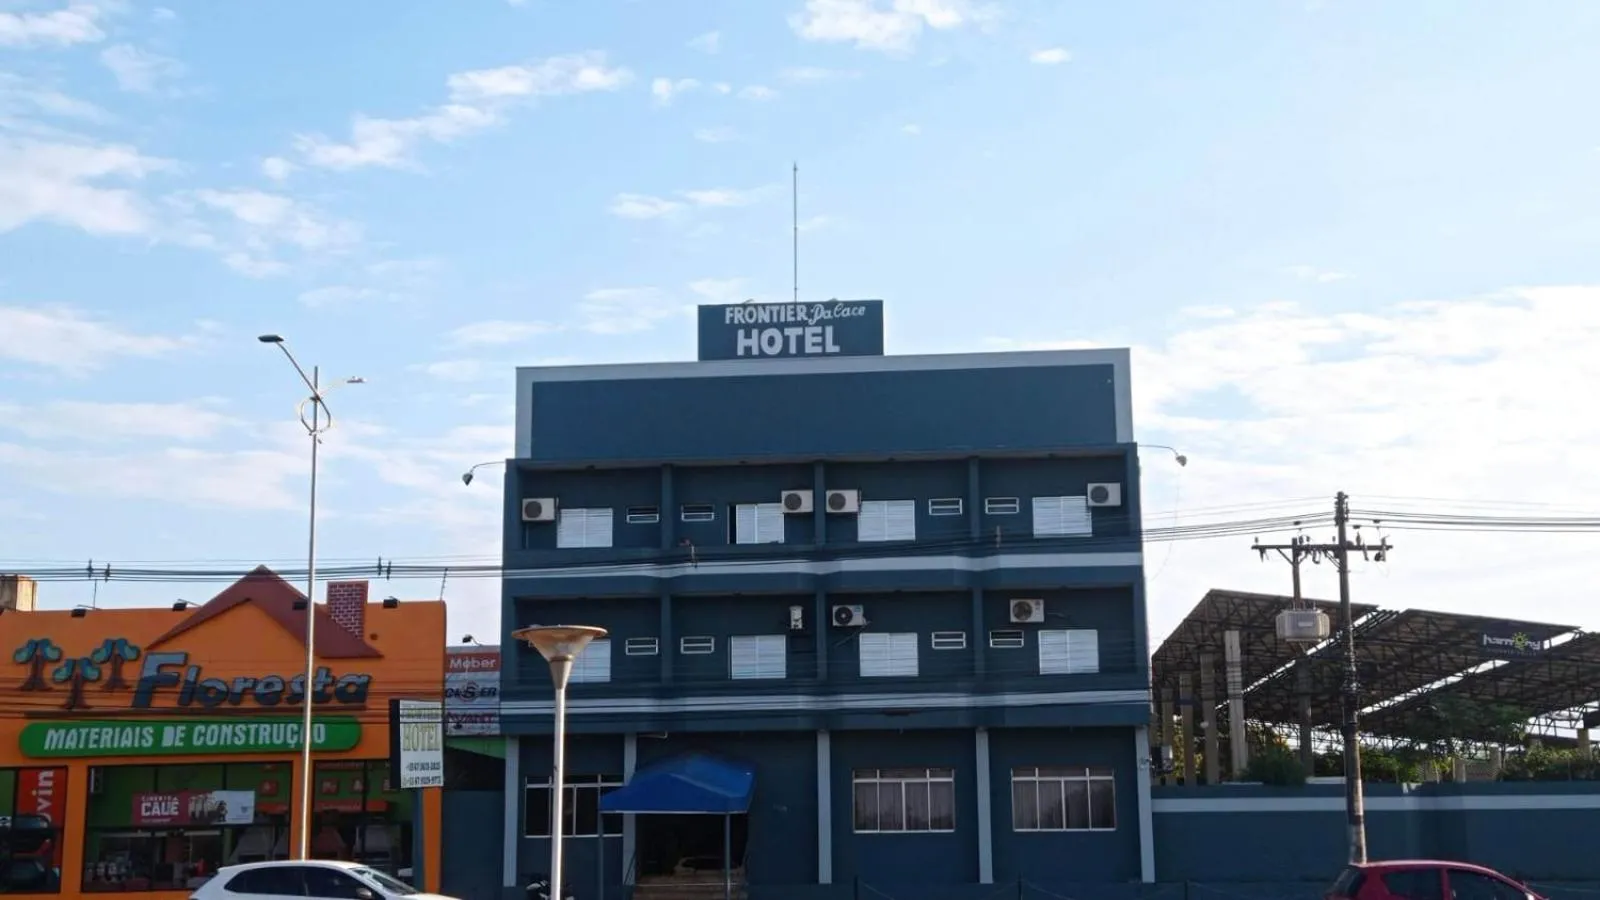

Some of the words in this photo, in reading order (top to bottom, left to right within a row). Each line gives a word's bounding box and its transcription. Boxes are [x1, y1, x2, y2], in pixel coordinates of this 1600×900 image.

[725, 304, 808, 324] FRONTIER
[736, 325, 840, 356] HOTEL
[131, 651, 373, 709] Floresta
[44, 725, 155, 750] MATERIAIS
[161, 725, 188, 748] DE
[403, 722, 440, 752] HOTEL
